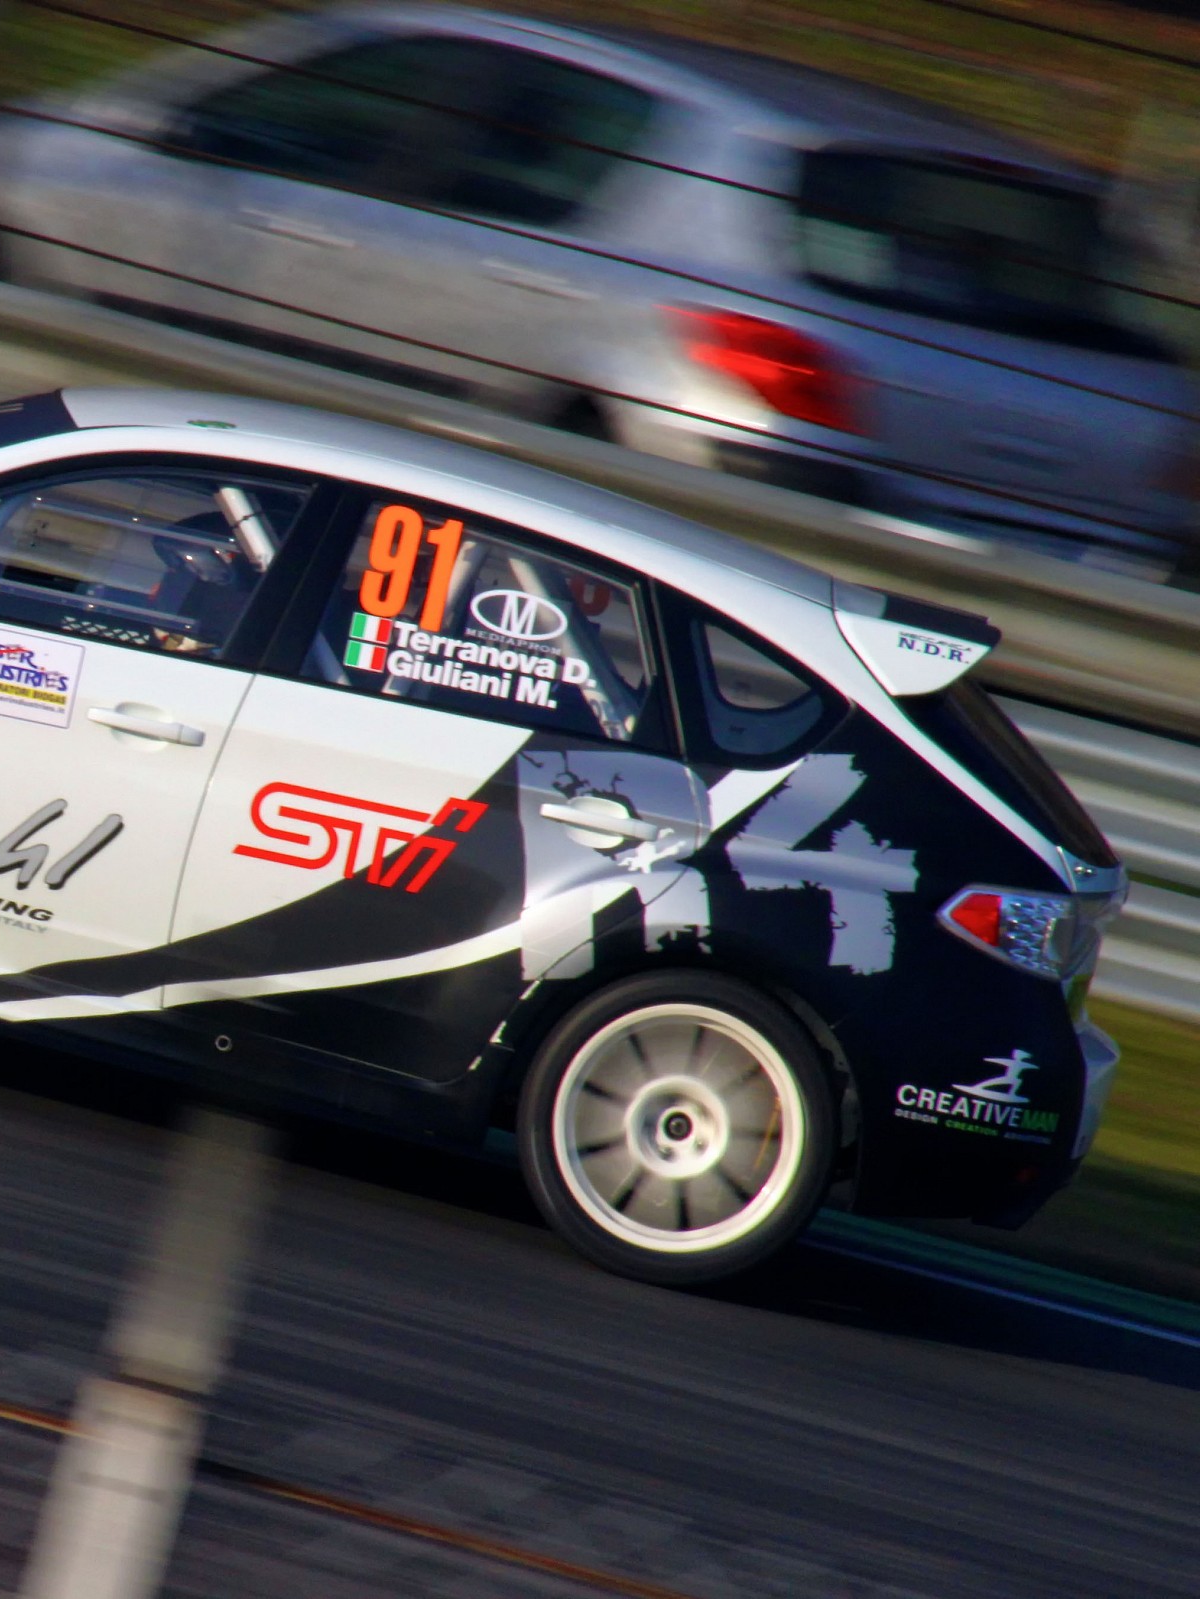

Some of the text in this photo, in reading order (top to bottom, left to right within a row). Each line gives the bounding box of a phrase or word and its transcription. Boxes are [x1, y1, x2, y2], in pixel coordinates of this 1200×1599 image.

[359, 504, 464, 632] 91
[386, 649, 557, 709] Giuliani M.
[394, 620, 597, 688] Terranova D.
[894, 1107, 939, 1125] DESIGN
